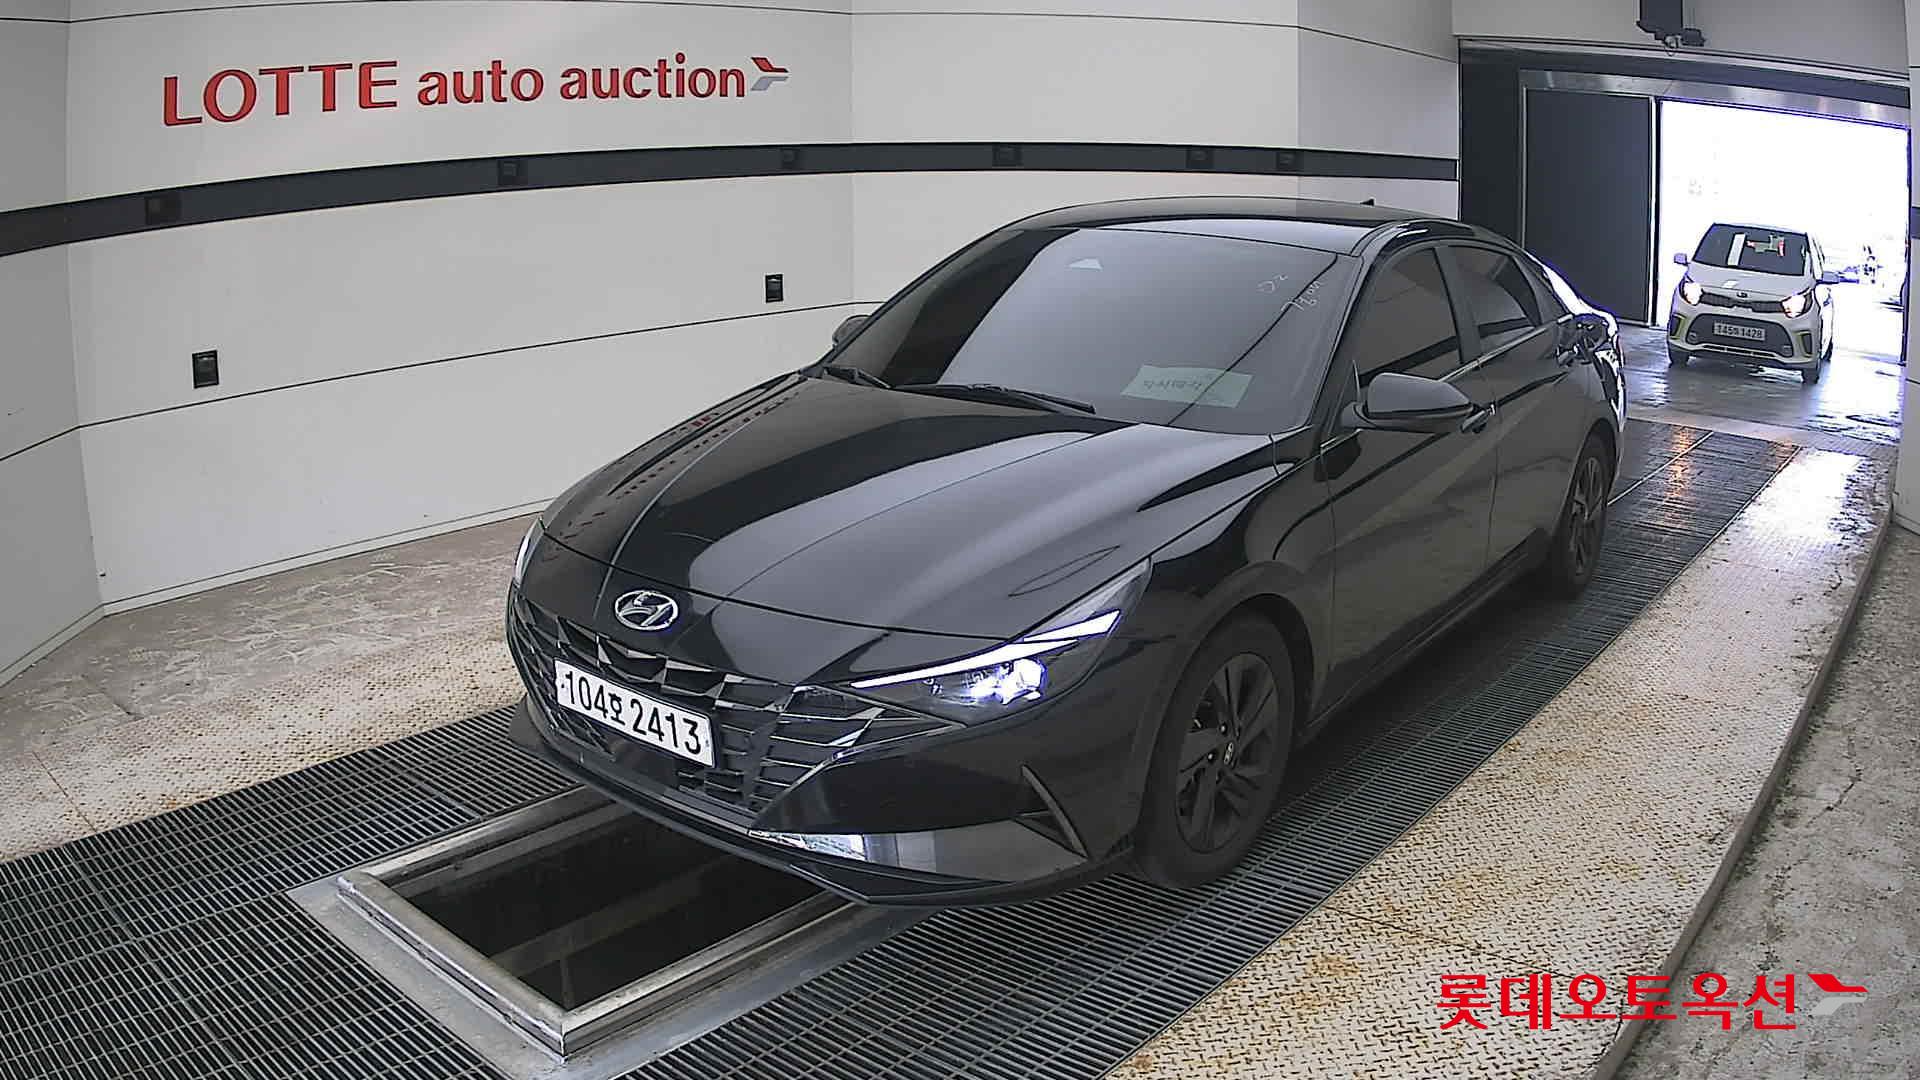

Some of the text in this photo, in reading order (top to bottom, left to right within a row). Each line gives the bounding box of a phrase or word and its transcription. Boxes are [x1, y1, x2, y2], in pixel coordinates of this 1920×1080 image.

[163, 52, 745, 126] LOTTE auto auction
[565, 671, 702, 755] 104호 2413
